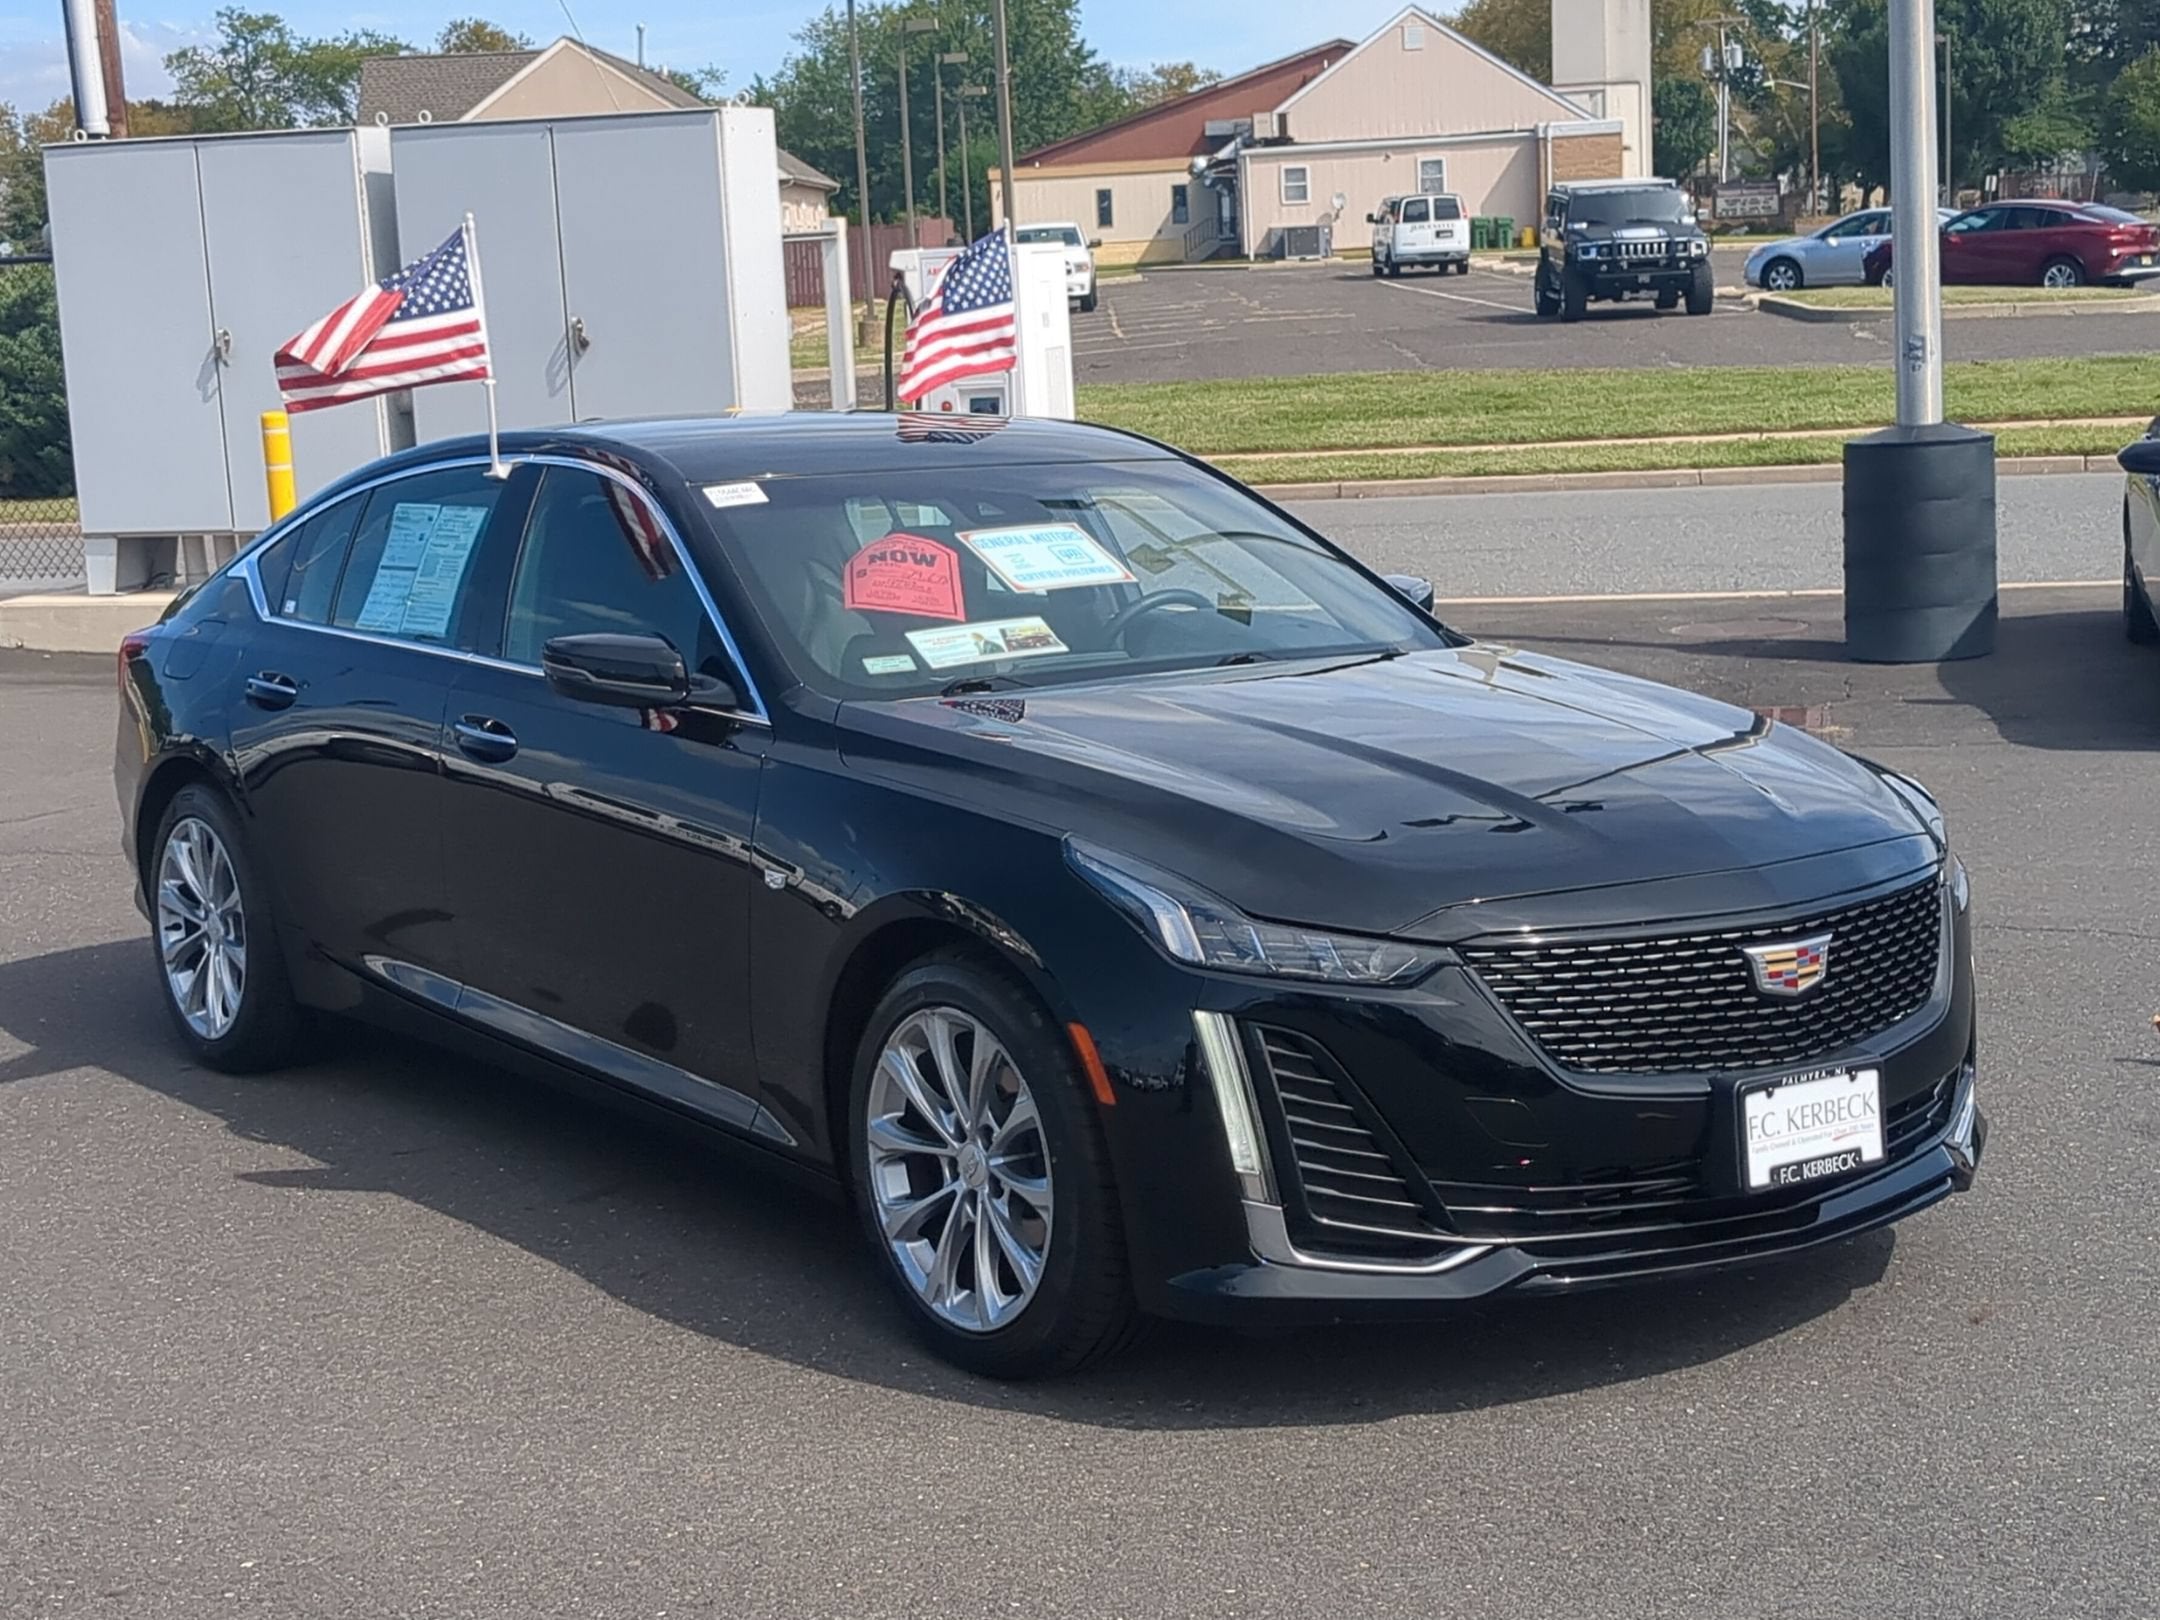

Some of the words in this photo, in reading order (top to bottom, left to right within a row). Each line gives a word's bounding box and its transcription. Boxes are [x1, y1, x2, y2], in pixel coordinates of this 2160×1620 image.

[1030, 531, 1083, 545] MOTORS
[868, 549, 938, 568] NOW
[1748, 1111, 1781, 1141] F.C.
[1786, 1090, 1876, 1133] KERBECK
[1779, 1165, 1801, 1185] F.C.
[1802, 1151, 1857, 1180] KERBECK
